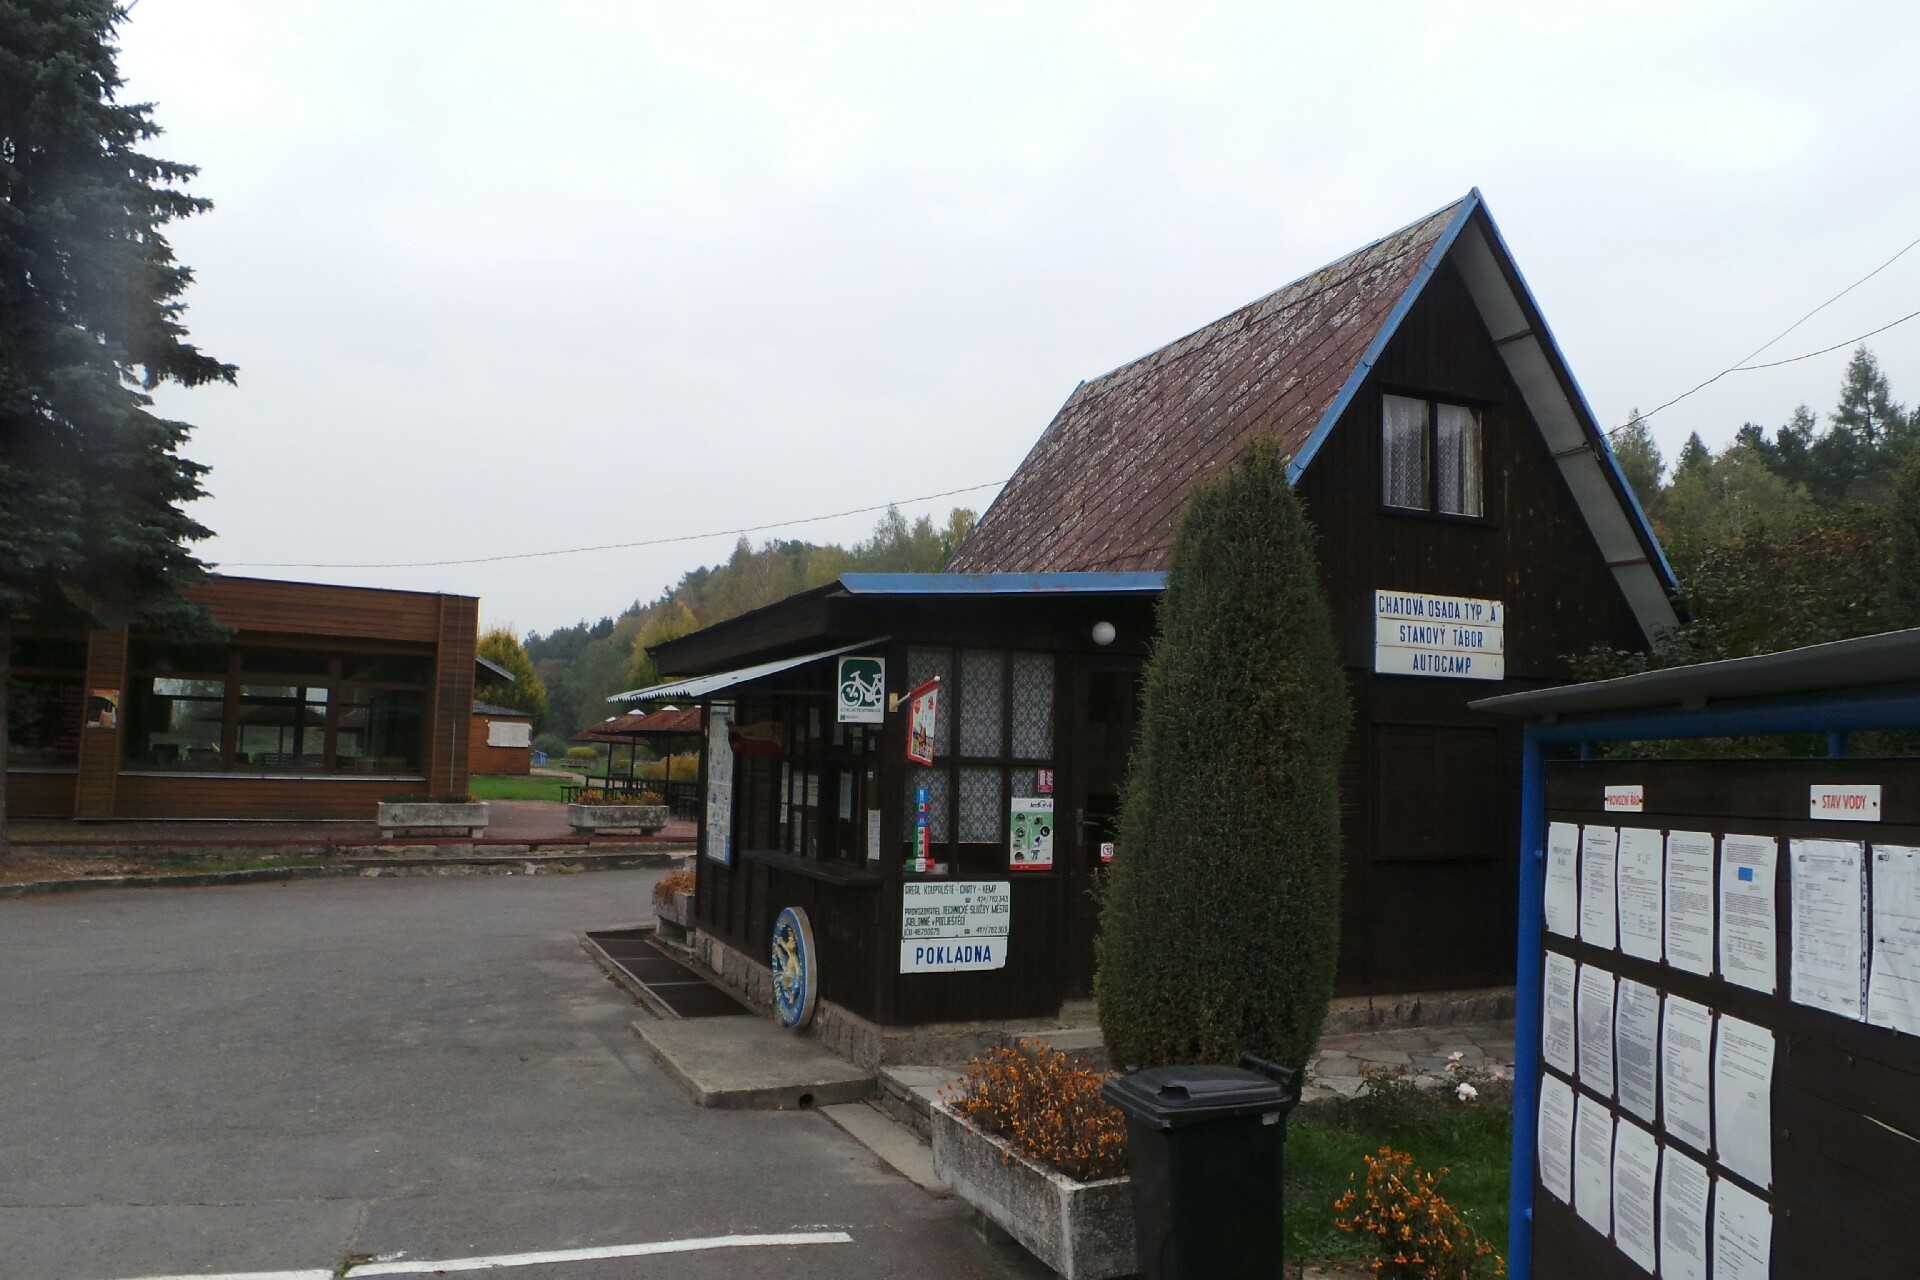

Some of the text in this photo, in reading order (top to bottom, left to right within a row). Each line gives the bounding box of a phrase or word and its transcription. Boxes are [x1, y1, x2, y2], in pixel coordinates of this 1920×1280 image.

[1379, 595, 1424, 616] CHATOVÁ
[1428, 600, 1461, 619] OSADA
[1465, 603, 1482, 621] TYP
[1400, 625, 1483, 648] STANOVÝ TÁBOR
[1413, 654, 1472, 674] AUTOCAMP
[1822, 794, 1867, 810] STAV VODY
[982, 884, 997, 894] KEMP
[916, 945, 992, 965] POKLADNA
